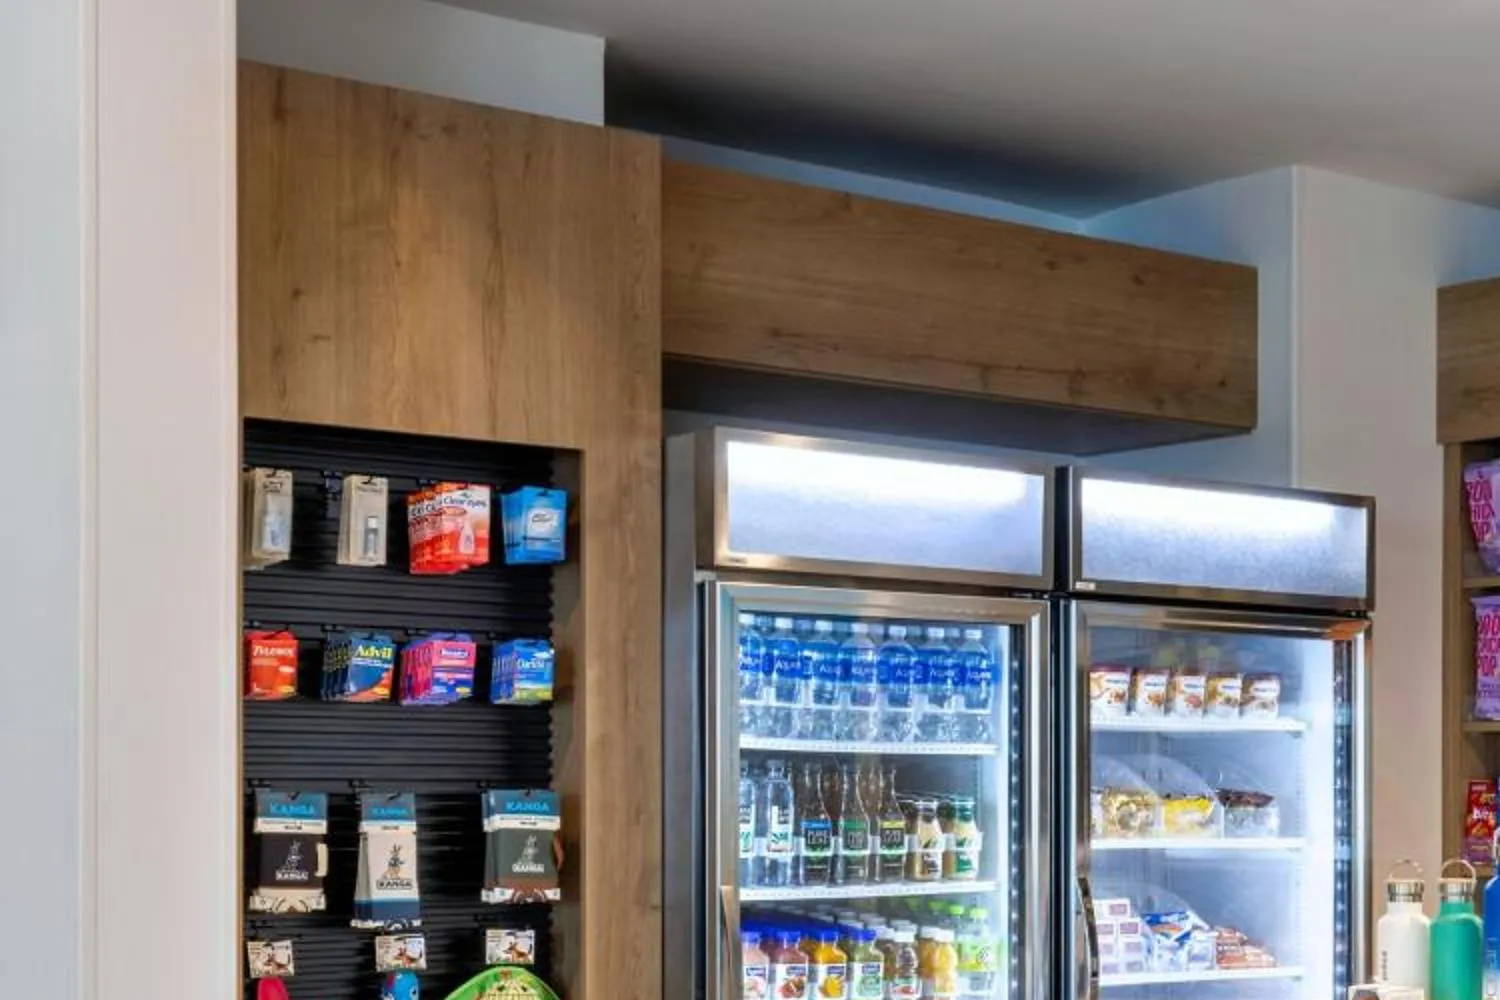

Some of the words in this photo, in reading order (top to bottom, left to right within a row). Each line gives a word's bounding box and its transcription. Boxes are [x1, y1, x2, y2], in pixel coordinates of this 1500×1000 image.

[355, 644, 393, 658] Advil
[269, 803, 316, 815] KANGA
[507, 801, 549, 811] KANGA
